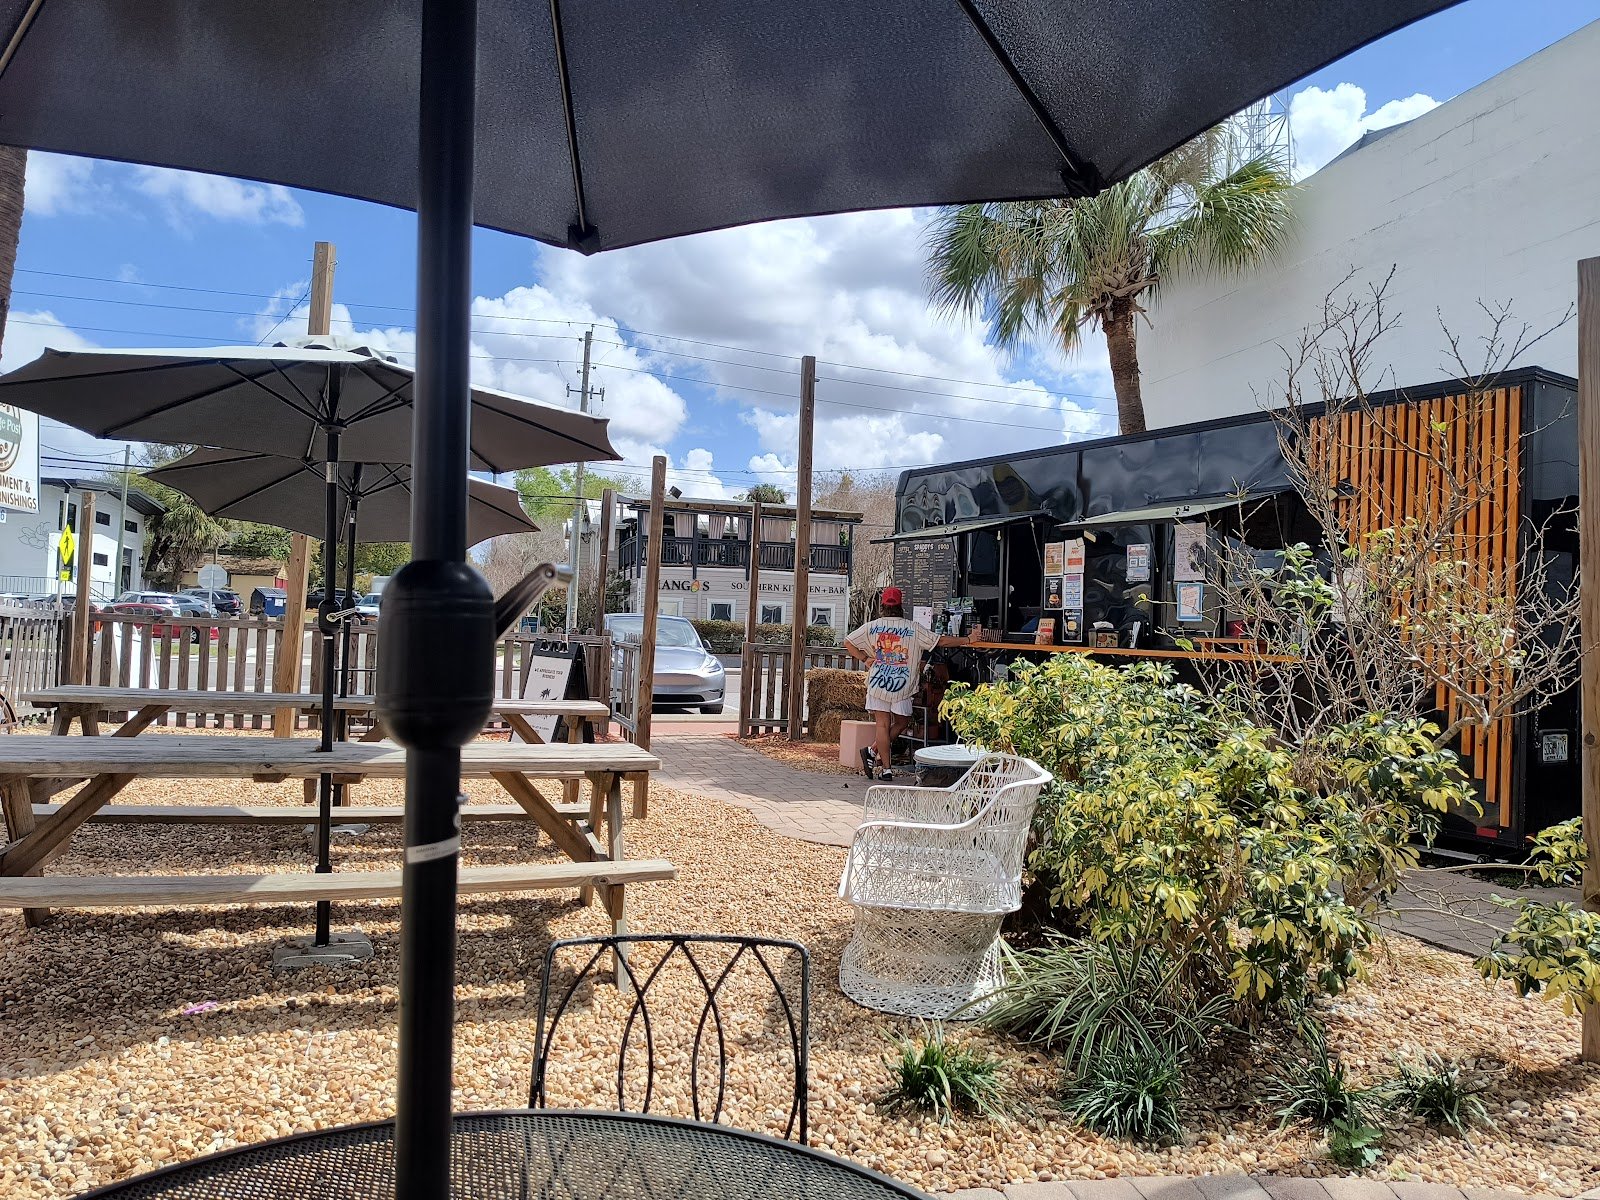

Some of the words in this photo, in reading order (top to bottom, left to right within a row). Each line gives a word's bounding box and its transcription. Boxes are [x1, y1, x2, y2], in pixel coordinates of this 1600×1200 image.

[7, 419, 21, 435] Post
[25, 481, 31, 493] &
[869, 625, 914, 638] WELCOME
[870, 670, 907, 692] HOOD
